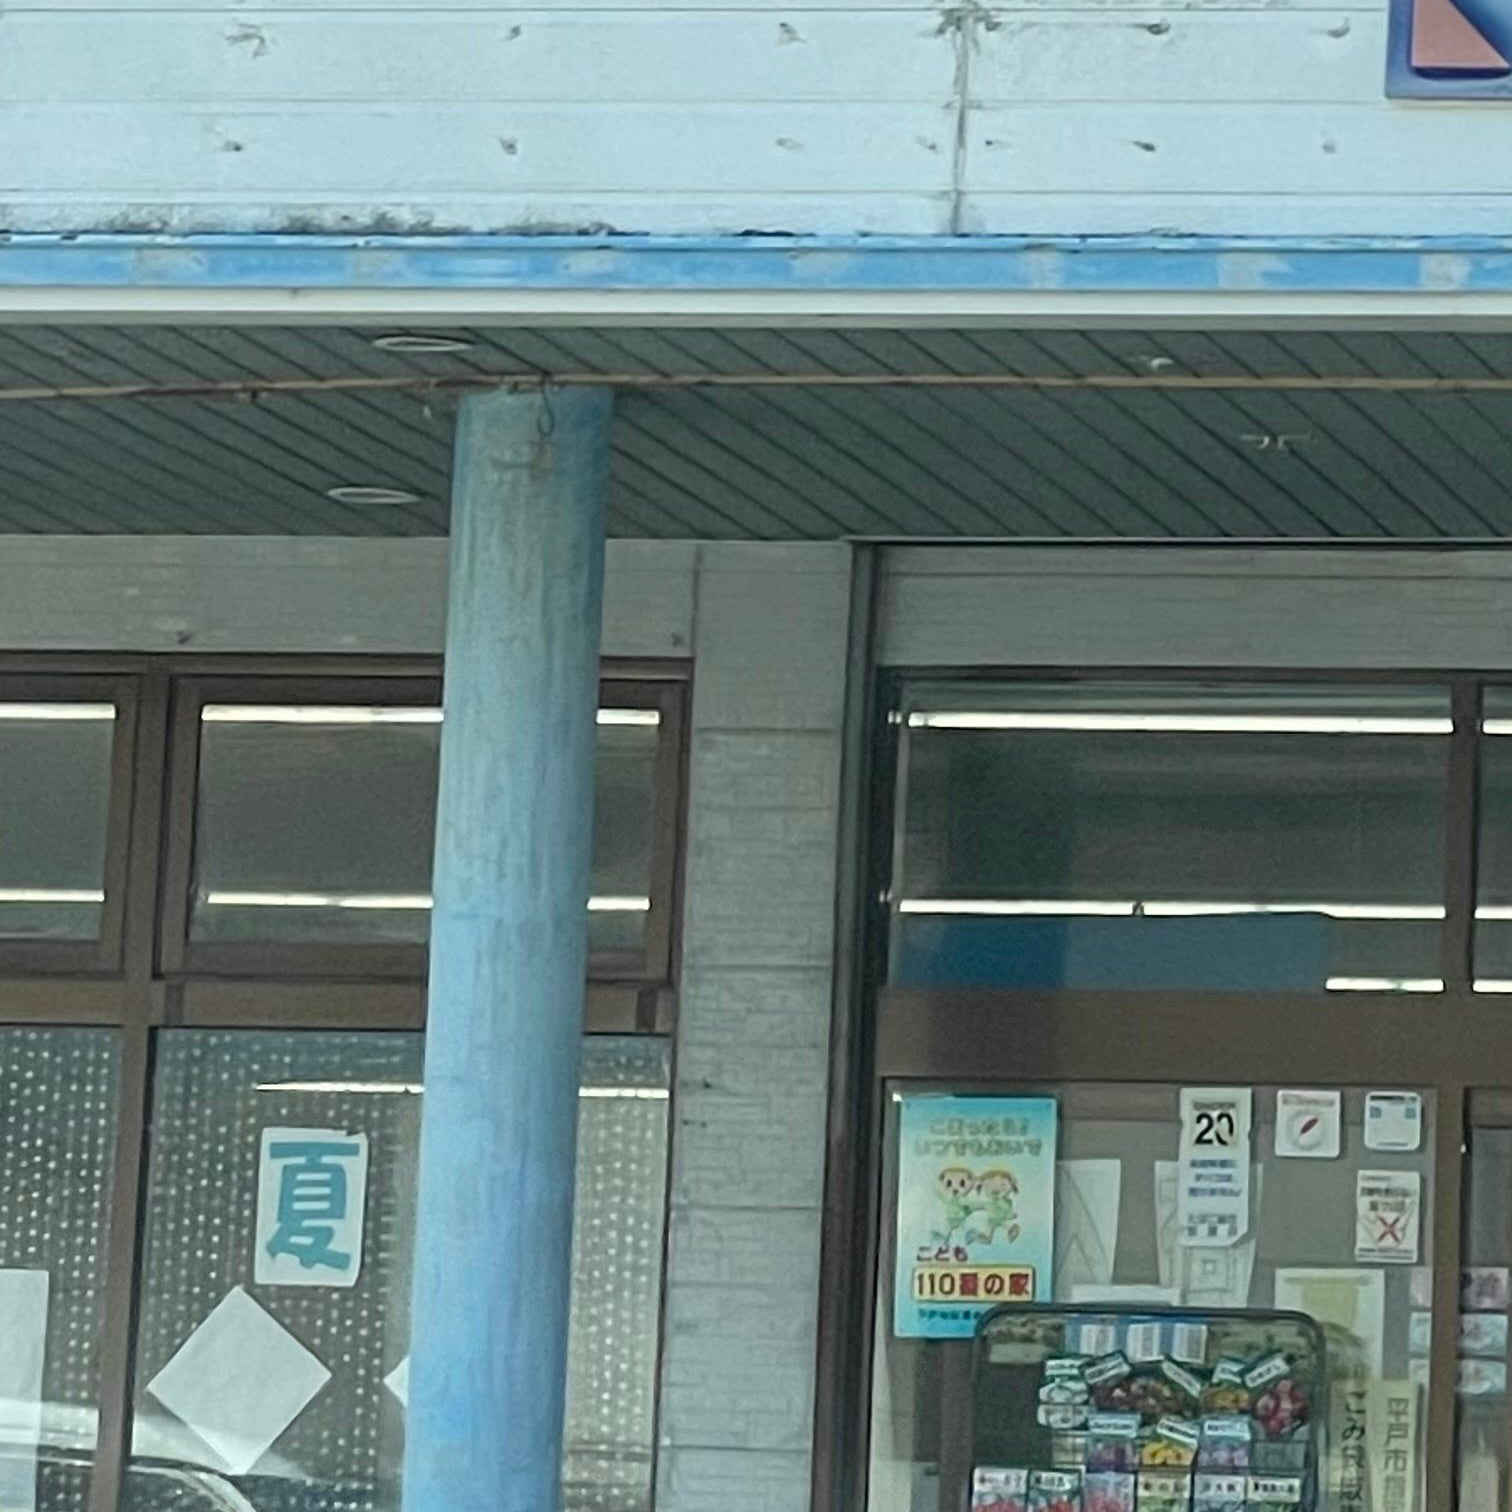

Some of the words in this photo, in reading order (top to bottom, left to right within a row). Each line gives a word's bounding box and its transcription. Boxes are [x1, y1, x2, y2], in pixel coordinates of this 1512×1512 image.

[1194, 1112, 1235, 1147] 20
[265, 1142, 361, 1271] 夏
[916, 1245, 969, 1263] こども
[917, 1271, 1031, 1297] 110番の家
